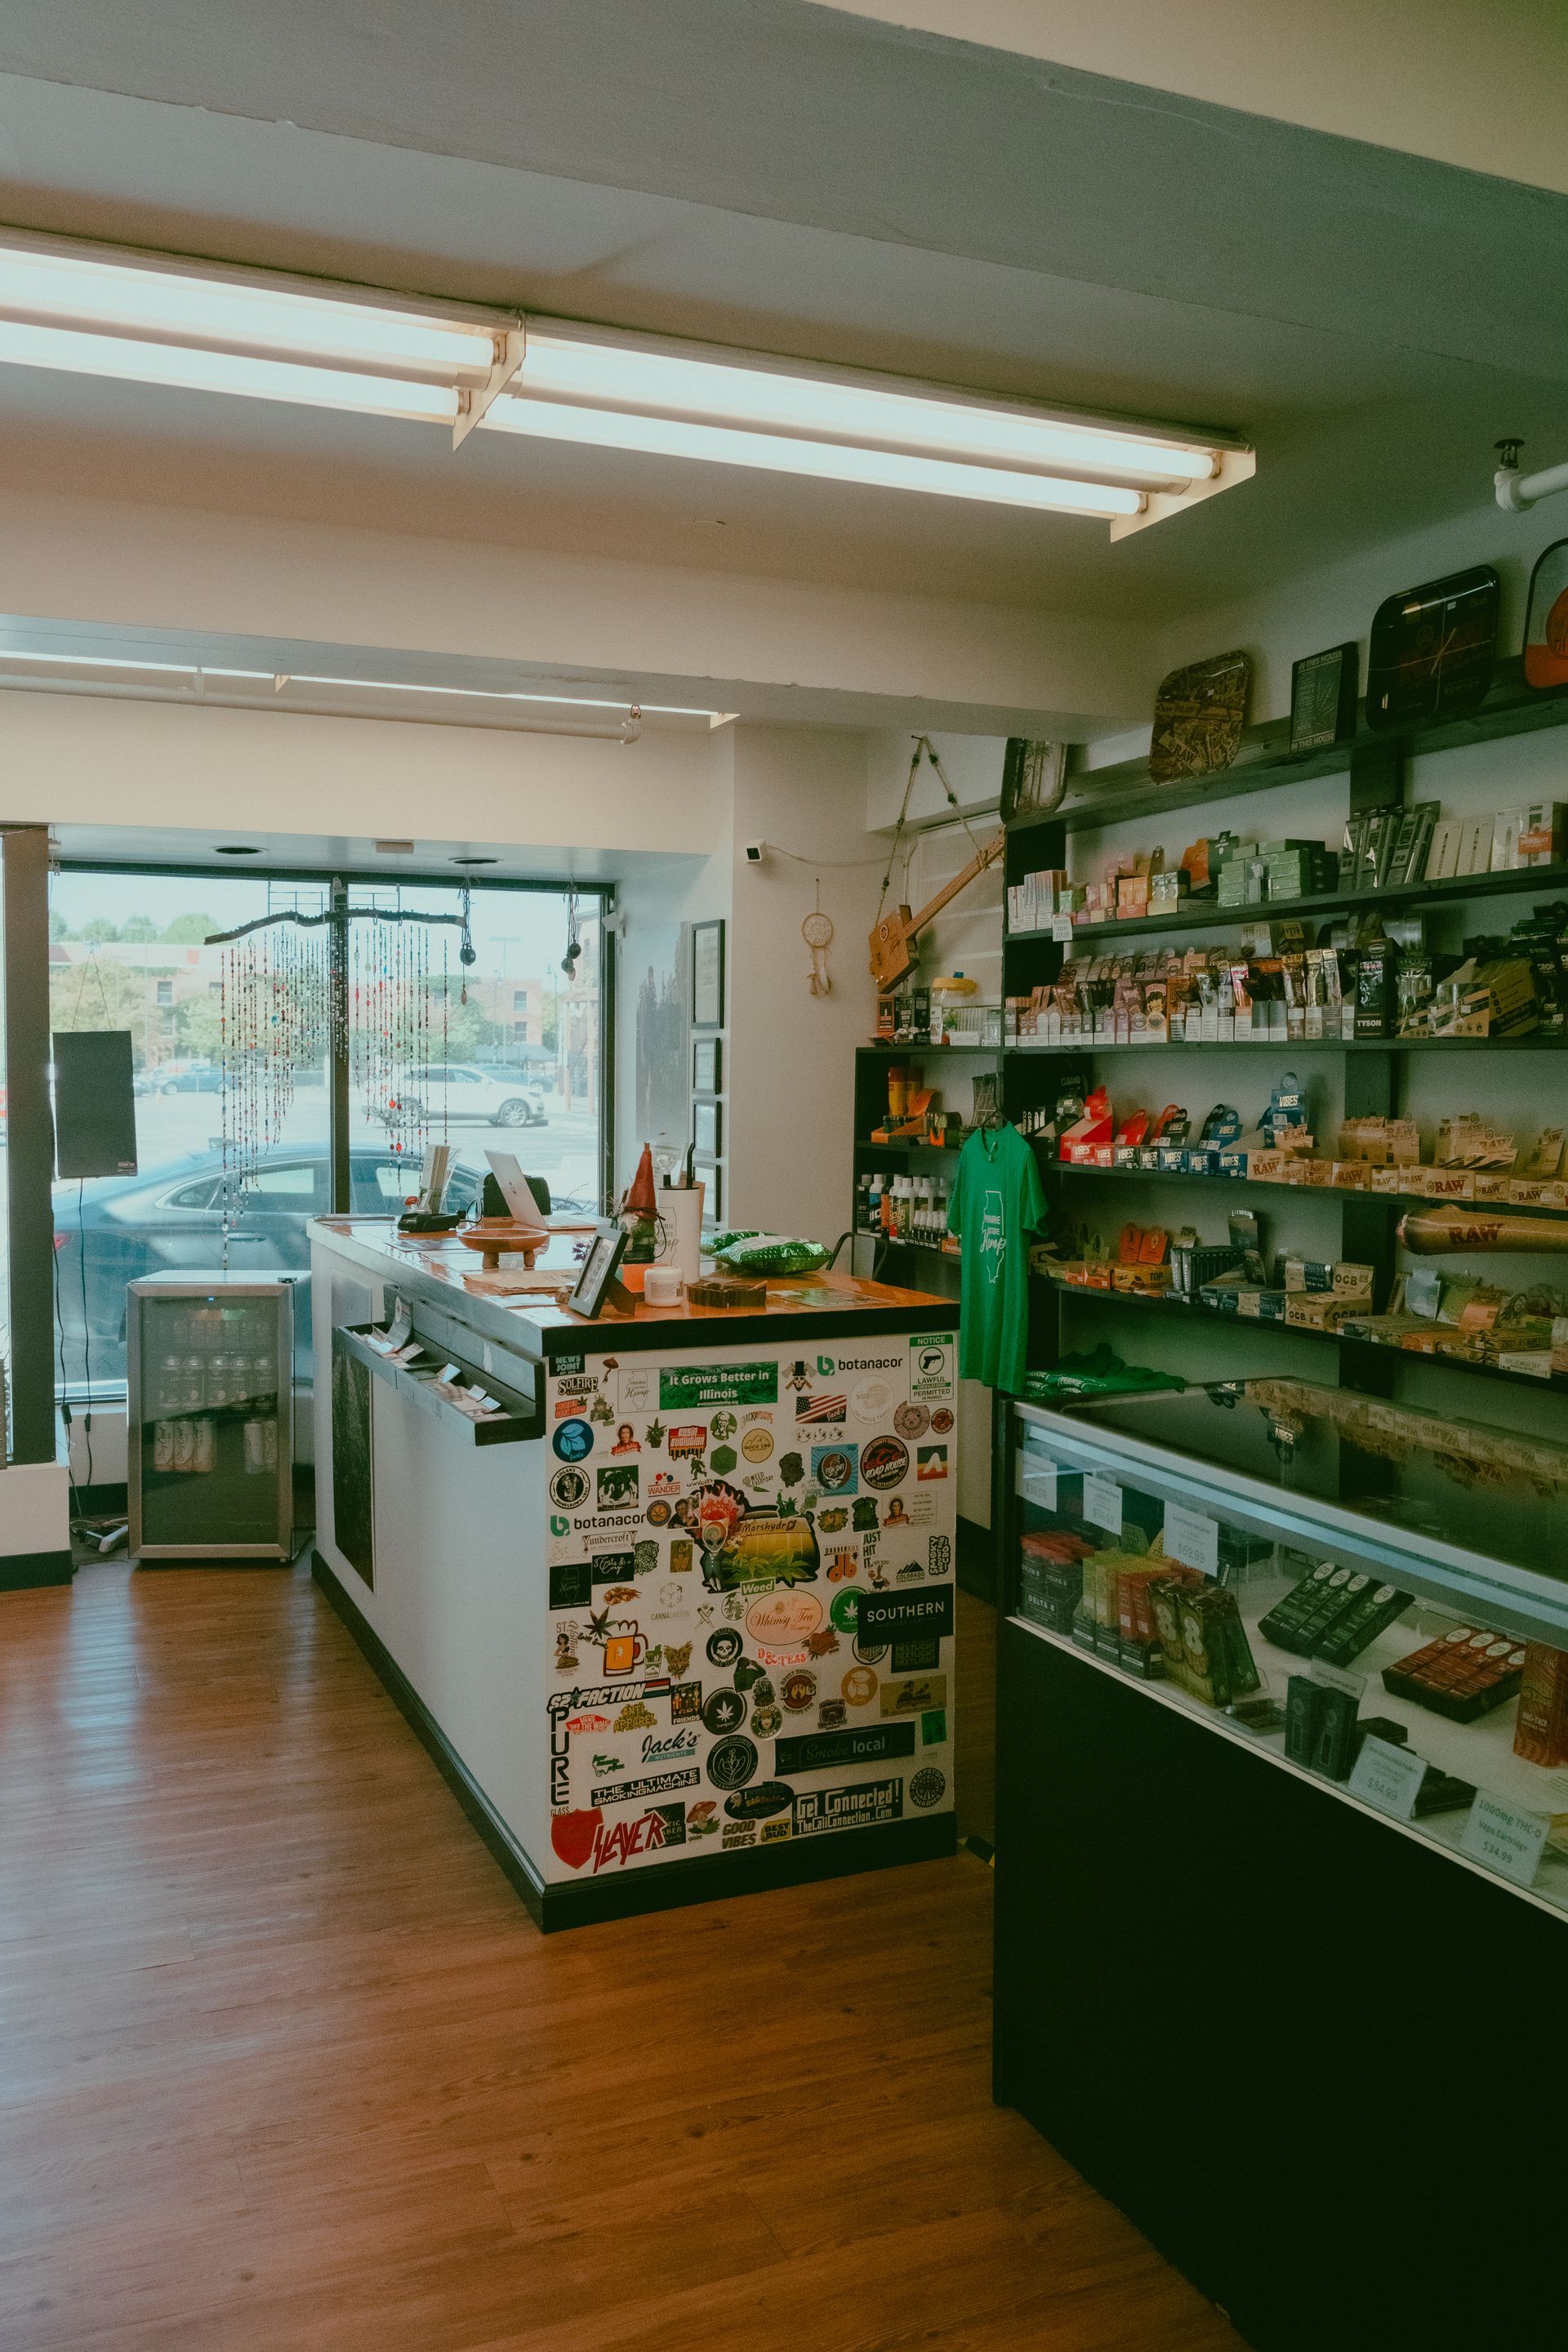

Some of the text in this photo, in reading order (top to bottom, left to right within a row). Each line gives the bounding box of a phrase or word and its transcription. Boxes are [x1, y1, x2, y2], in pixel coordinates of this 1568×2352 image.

[1298, 738, 1312, 749] THIS
[1279, 1094, 1299, 1107] VIBES
[1218, 1125, 1236, 1134] VIBES
[1075, 1145, 1091, 1156] VIBES
[1097, 1148, 1111, 1158] VIBES
[1117, 1148, 1134, 1160] VIBES
[1143, 1152, 1158, 1162] VIBES
[1164, 1152, 1183, 1163] VIBES
[1221, 1156, 1240, 1167] VIBES
[1338, 1169, 1364, 1182] RAW
[1376, 1176, 1393, 1186] RAW
[1404, 1174, 1423, 1185] RAW
[1435, 1179, 1466, 1194] RAW
[1481, 1185, 1501, 1195] RAW
[1517, 1190, 1543, 1201] RAW
[1448, 1223, 1505, 1245] RAW
[1149, 1272, 1163, 1282] TOP
[1335, 1273, 1358, 1286] OCB
[1289, 1311, 1306, 1321] OCB
[1332, 1311, 1358, 1321] OCB
[917, 1335, 946, 1345] NOTICE
[555, 1356, 581, 1364] NEWS
[838, 1356, 903, 1370] botanacor
[556, 1362, 580, 1372] JOINT
[670, 1370, 769, 1386] It Grows Better in
[917, 1376, 947, 1385] LAWFUL
[558, 1377, 599, 1396] SOLFIRE
[913, 1388, 951, 1397] PERMITTED
[624, 1387, 650, 1399] Hemp
[700, 1388, 738, 1401] Illinois
[872, 1439, 887, 1450] COUNTY
[865, 1467, 884, 1480] ROAD
[884, 1456, 907, 1472] HOUSE
[751, 1472, 764, 1481] WEED
[751, 1475, 774, 1486] EVERYDAY
[648, 1484, 681, 1495] WANDER
[574, 1513, 646, 1530] botanacor
[590, 1532, 630, 1547] undercroft
[863, 1530, 881, 1545] JUST
[862, 1544, 876, 1557] HIT
[864, 1557, 873, 1569] IT.
[896, 1572, 925, 1581] COLORADO
[742, 1581, 773, 1594] Weed
[1028, 1594, 1055, 1613] DELTA 8
[866, 1601, 944, 1623] SOUTHERN
[750, 1606, 814, 1631] Whimsy Tea
[577, 1682, 646, 1708] FACTION
[579, 1714, 596, 1723] VANS
[673, 1714, 701, 1725] FRIENDS
[581, 1721, 594, 1731] THE
[758, 1728, 777, 1739] FARMS
[641, 1728, 698, 1764] Jack's
[712, 1737, 729, 1753] CUSTOM
[738, 1737, 753, 1747] COFFEE
[805, 1736, 886, 1762] Smoke local
[550, 1707, 570, 1806] PURE
[654, 1750, 687, 1761] NUTRIENTS
[593, 1785, 622, 1798] THE
[630, 1769, 698, 1791] ULTIMATE
[910, 1767, 946, 1791] HEMPSTOCK
[593, 1778, 698, 1806] SMOKINGMACHINE
[1366, 1778, 1397, 1801] $34.99
[797, 1793, 819, 1820] Get
[825, 1779, 900, 1815] Connected!
[911, 1793, 943, 1808] PHARMS
[550, 1806, 570, 1818] GLASS
[1478, 1799, 1543, 1838] 1000mg THC-O
[722, 1820, 755, 1836] GOOD
[764, 1822, 790, 1832] BEST
[1478, 1820, 1496, 1835] Vape
[765, 1830, 787, 1839] BUD
[593, 1811, 668, 1875] SLAYER
[722, 1833, 756, 1850] VIBES
[1482, 1841, 1512, 1864] $34.99
